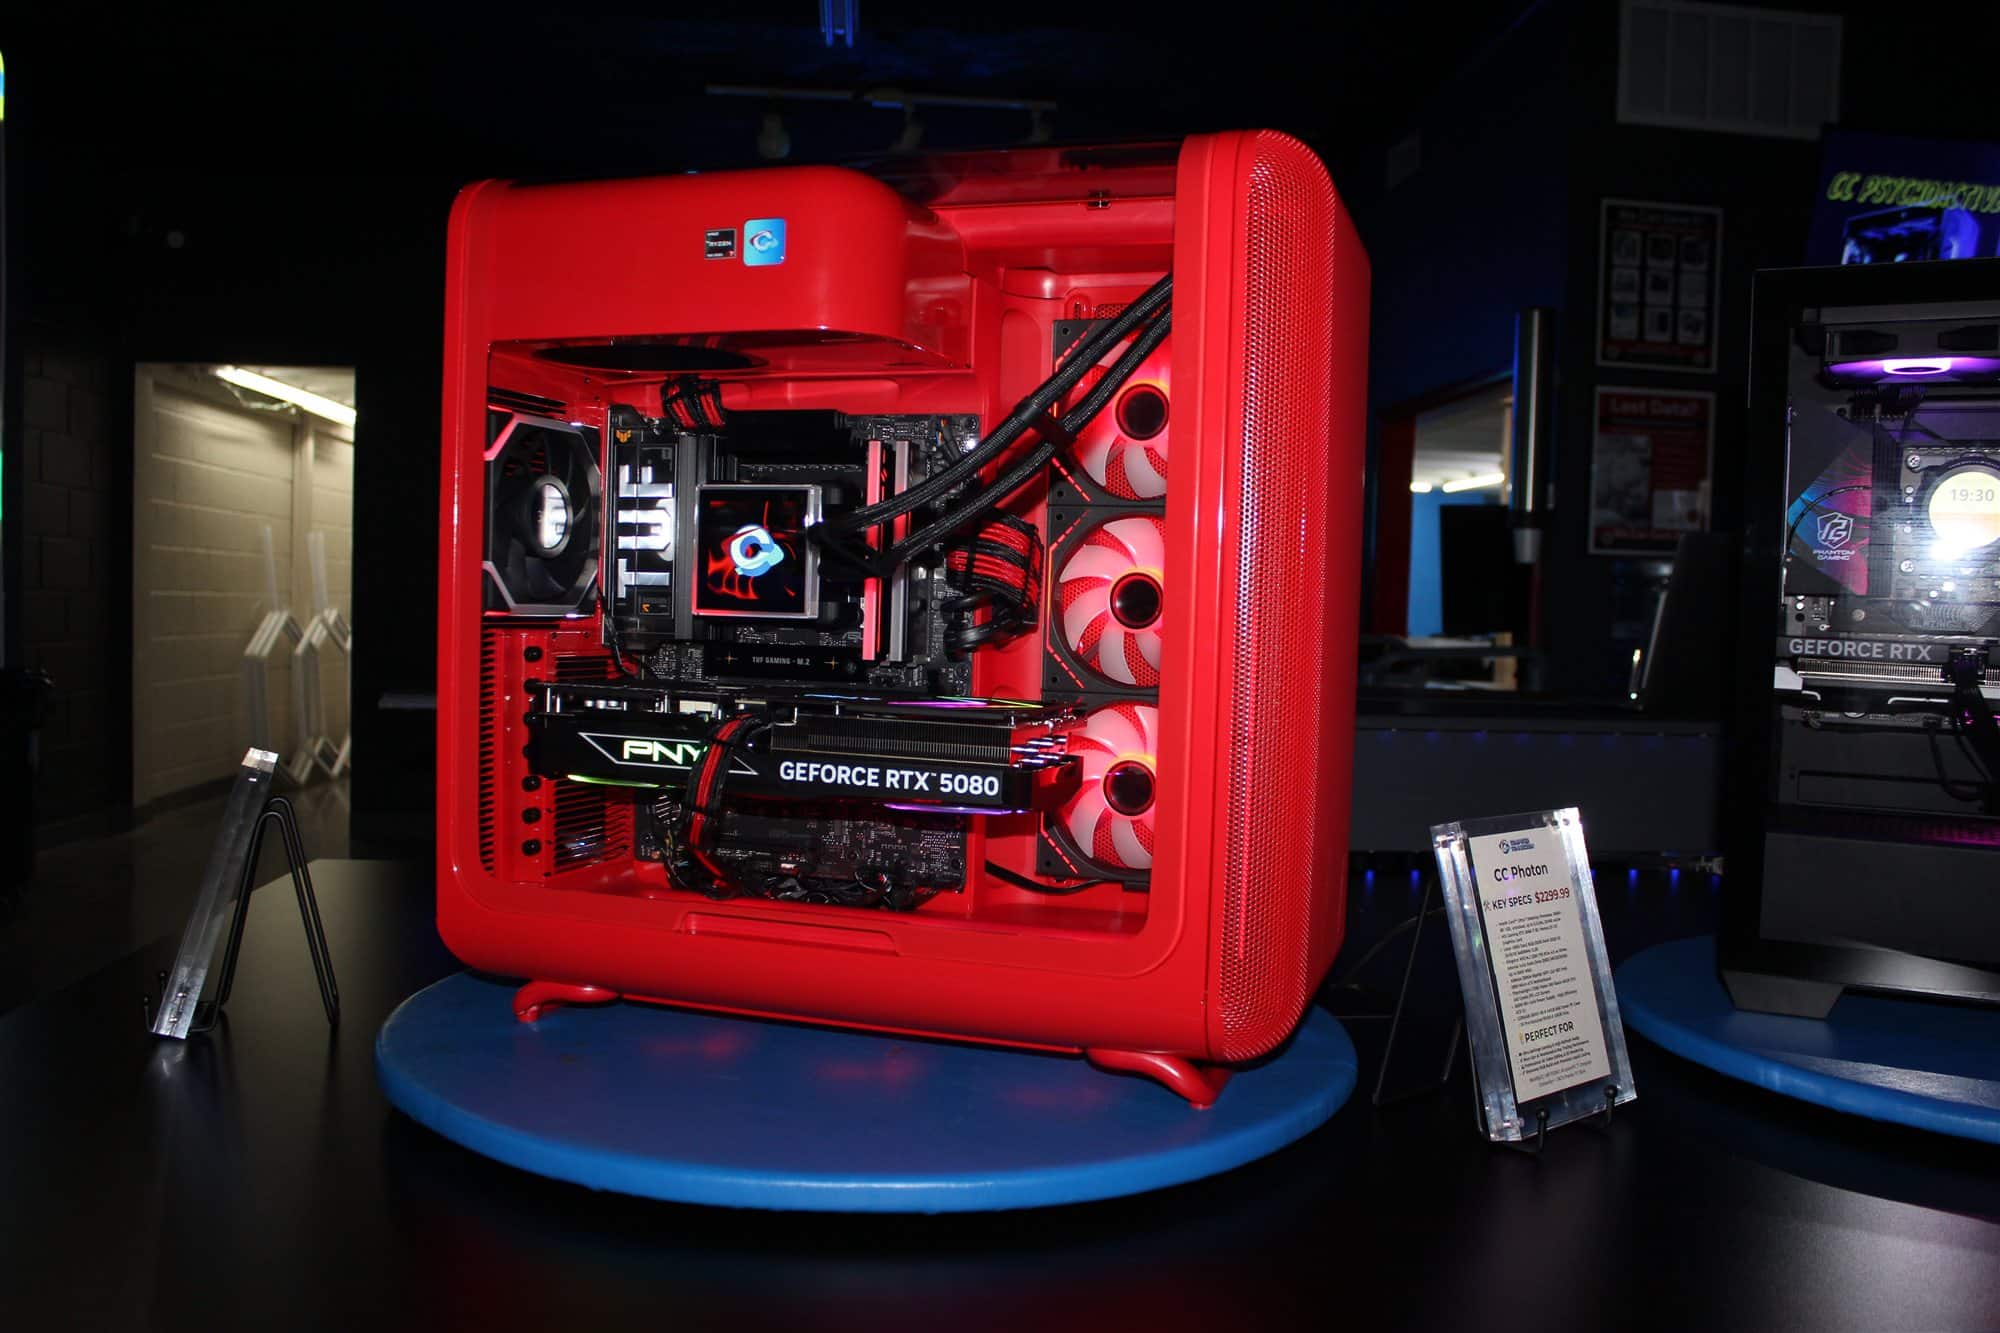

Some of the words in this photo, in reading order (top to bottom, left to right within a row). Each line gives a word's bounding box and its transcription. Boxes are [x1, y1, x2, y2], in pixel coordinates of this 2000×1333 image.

[1951, 488, 1995, 502] 19:30
[617, 464, 674, 599] TUF
[765, 656, 791, 665] GAMING
[1789, 638, 1884, 658] GEFORCE
[1889, 644, 1932, 661] RTX
[623, 740, 708, 765] PNY
[779, 761, 880, 788] GEFORCE
[939, 774, 1000, 797] 5080
[1494, 868, 1510, 882] CC
[1511, 864, 1549, 880] Photon
[1493, 899, 1507, 910] KEY
[1508, 895, 1533, 908] SPECS
[1534, 887, 1570, 904] $2299.99
[1525, 1025, 1557, 1043] PERFECT
[1558, 1021, 1574, 1034] FOR
